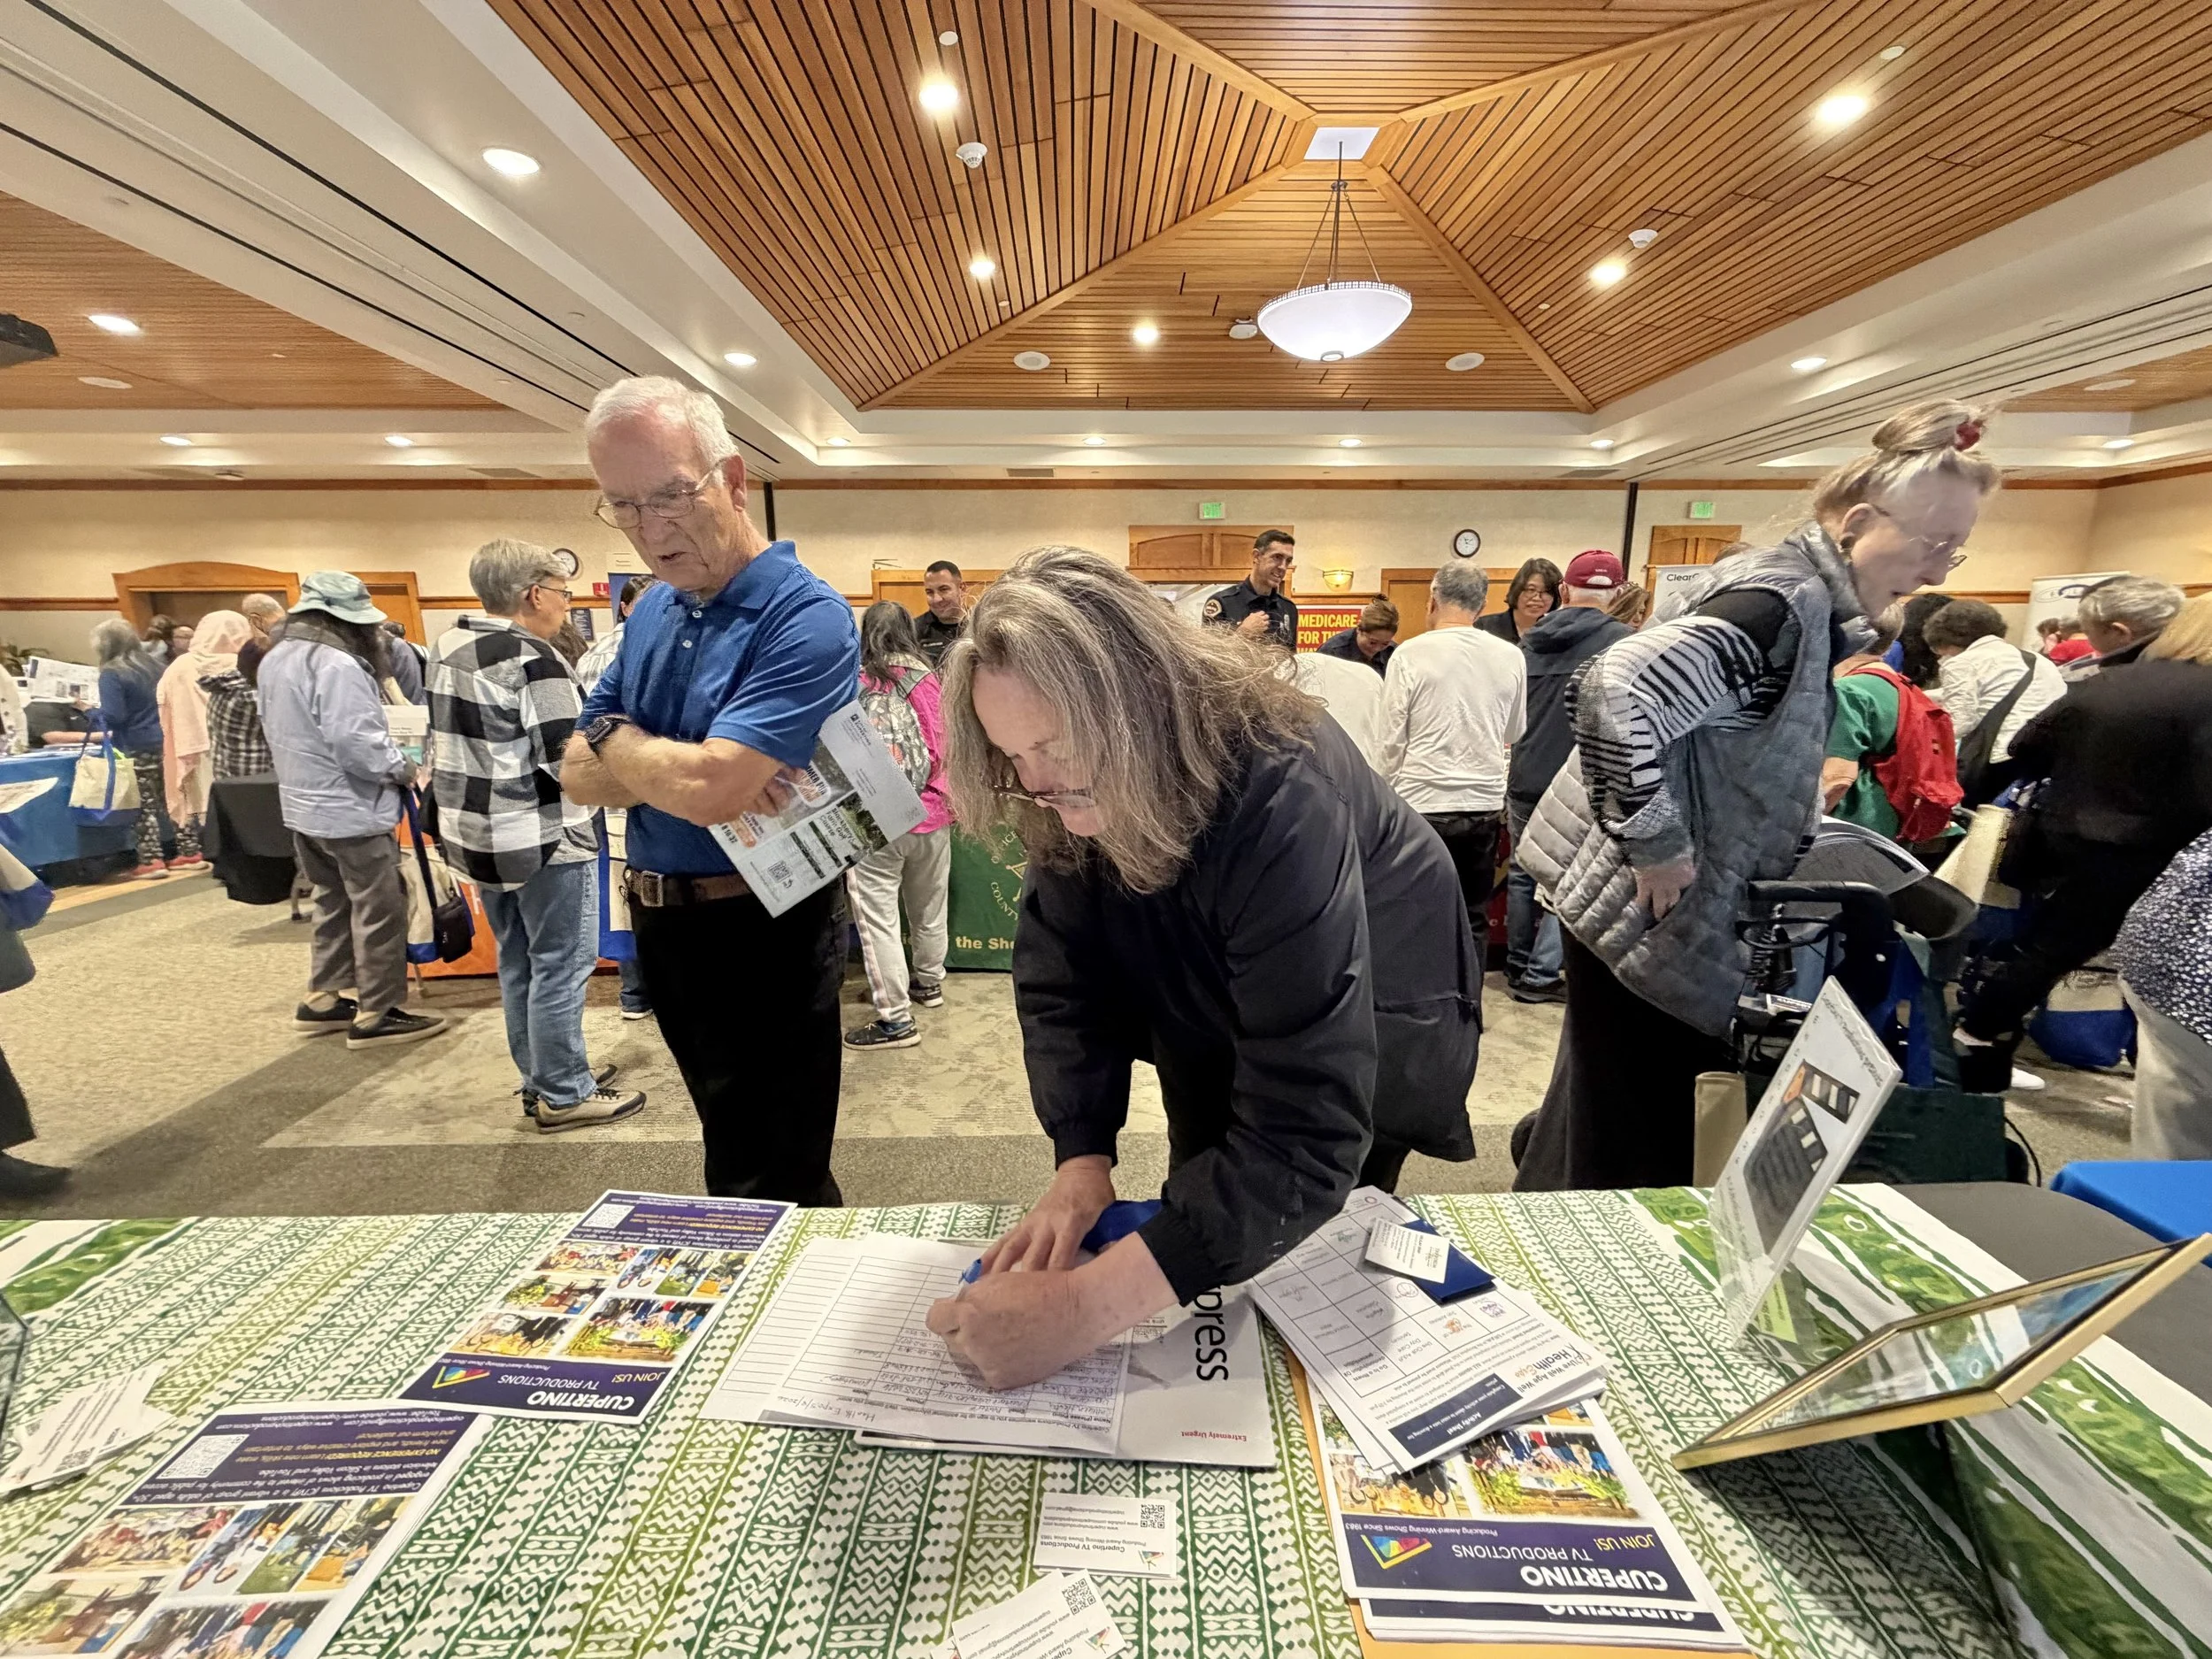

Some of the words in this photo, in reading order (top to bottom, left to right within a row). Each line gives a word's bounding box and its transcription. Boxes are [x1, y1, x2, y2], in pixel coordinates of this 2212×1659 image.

[1299, 614, 1357, 627] MEDICARE
[1297, 631, 1319, 644] FOR
[956, 936, 982, 949] the
[1195, 1287, 1228, 1382] press
[1532, 1350, 1571, 1371] Health
[611, 1373, 632, 1383] US!
[630, 1372, 665, 1382] JOIN
[1532, 1373, 1548, 1384] Age
[1548, 1366, 1565, 1379] Well
[497, 1375, 585, 1389] PRODUCTIONS
[582, 1380, 600, 1390] TV
[1517, 1380, 1536, 1394] Well
[526, 1391, 635, 1410] CUPERTINO
[1181, 1430, 1207, 1439] Urgent
[1209, 1432, 1248, 1442] Extremely
[1363, 1524, 1384, 1532] Since
[1384, 1525, 1408, 1533] Shows
[1409, 1525, 1461, 1535] Award-Winning
[1462, 1527, 1499, 1537] Producing
[1041, 1540, 1079, 1549] Productions
[1593, 1538, 1616, 1552] US!
[1616, 1534, 1655, 1548] JOIN
[1092, 1544, 1125, 1553] Cupertino
[1451, 1543, 1568, 1559] PRODUCTIONS
[1573, 1547, 1594, 1561] TV
[1521, 1564, 1669, 1592] CUPERTINO
